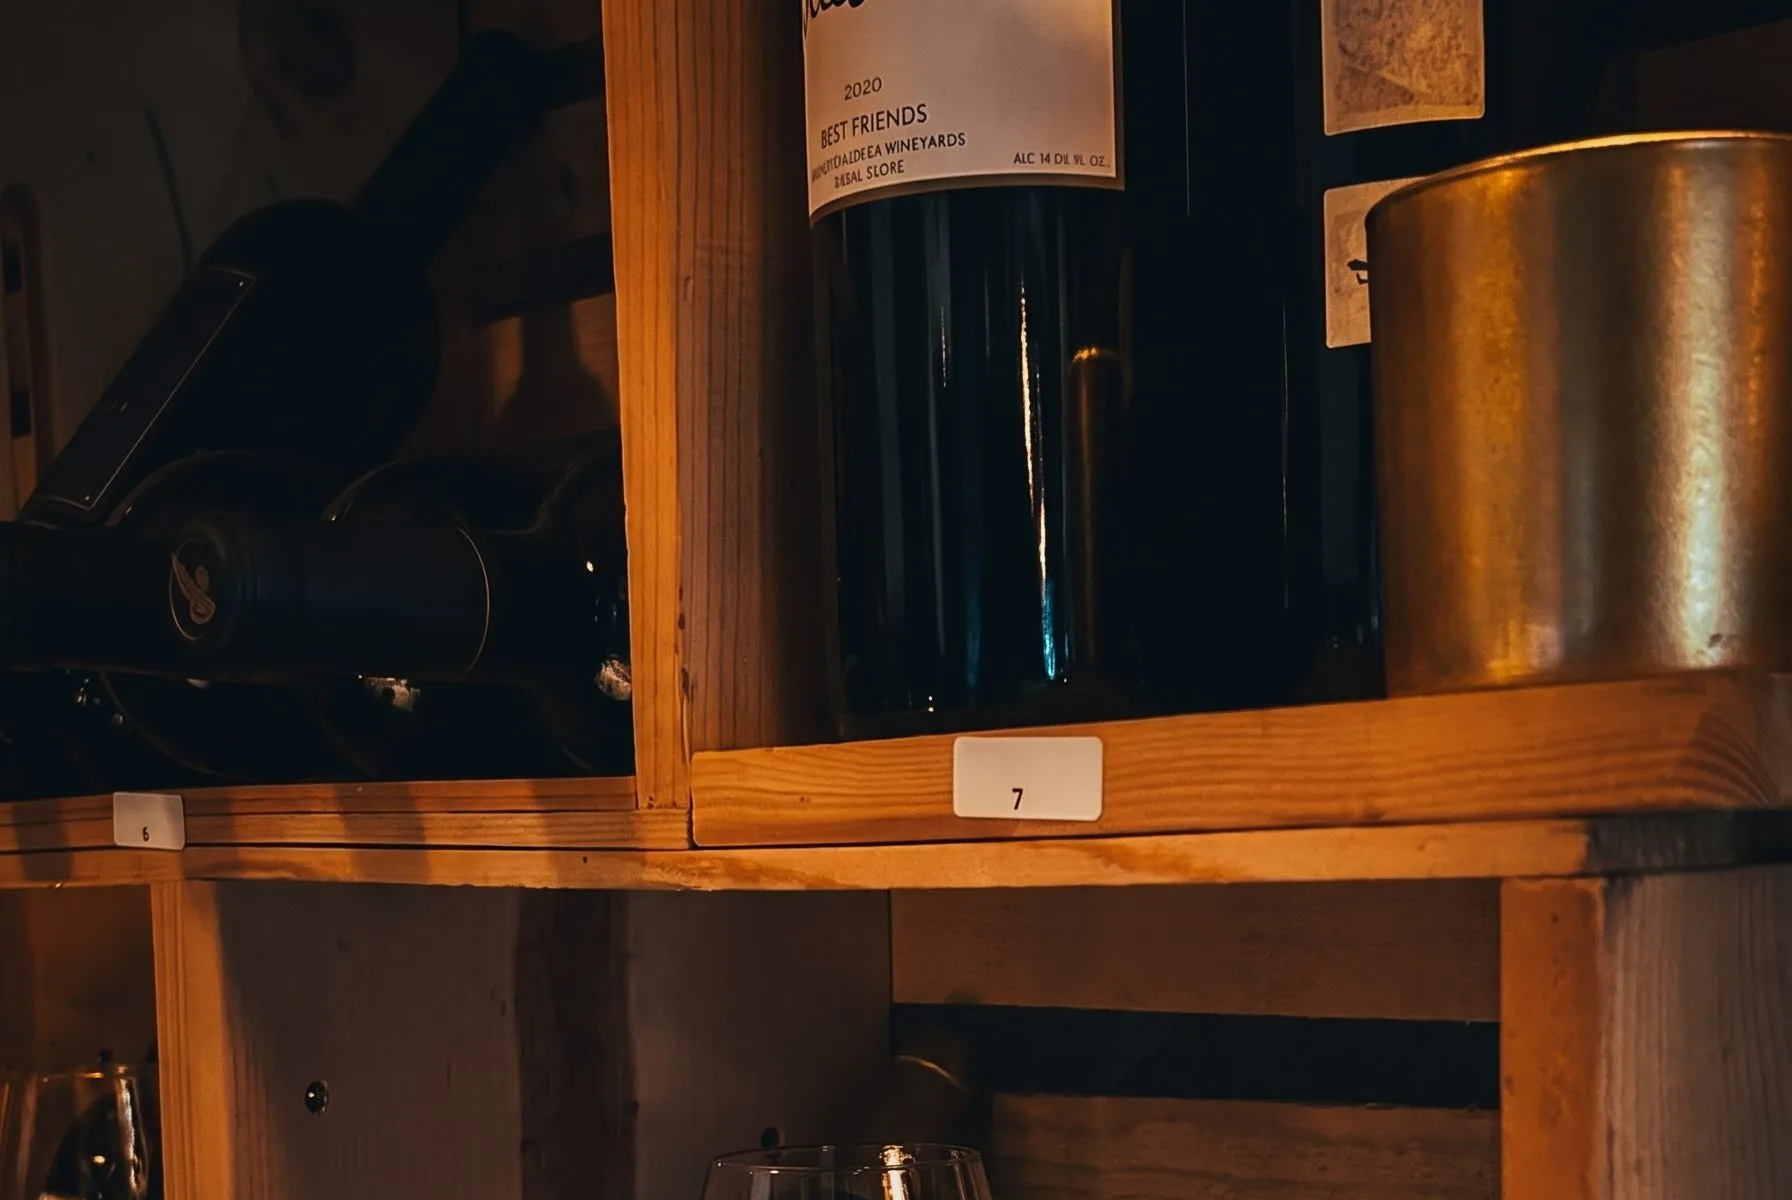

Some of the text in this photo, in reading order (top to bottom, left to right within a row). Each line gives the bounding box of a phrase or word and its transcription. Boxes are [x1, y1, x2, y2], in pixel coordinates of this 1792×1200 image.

[844, 76, 882, 101] 2020
[821, 103, 928, 150] BEST FRIENDS
[885, 132, 966, 156] WINEYARDS
[1012, 788, 1024, 811] 7
[142, 826, 150, 842] 6
